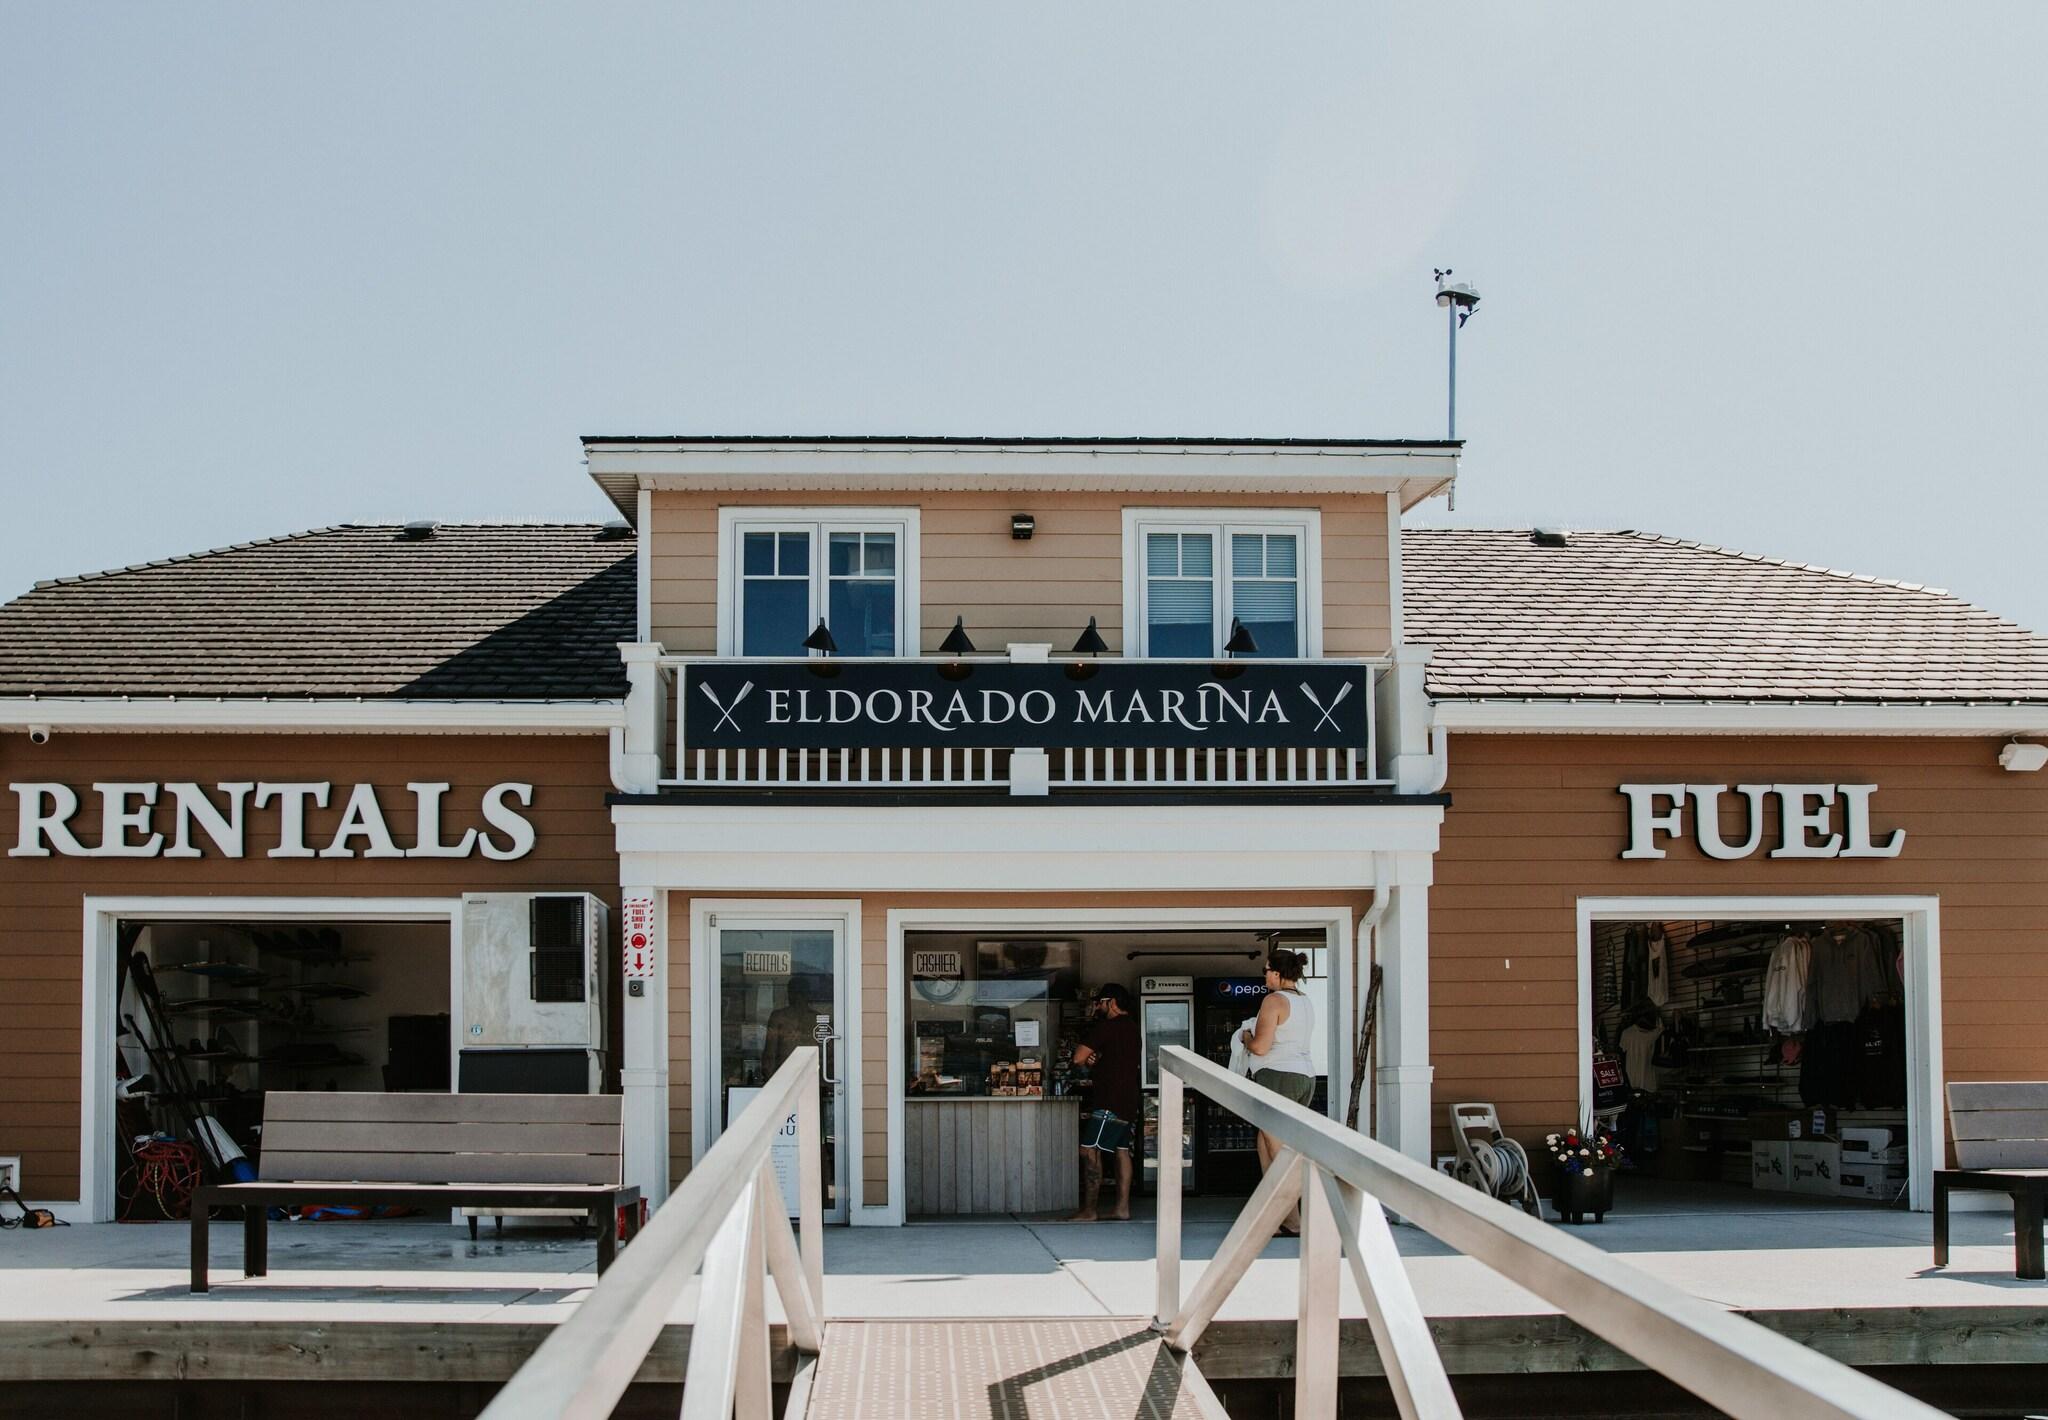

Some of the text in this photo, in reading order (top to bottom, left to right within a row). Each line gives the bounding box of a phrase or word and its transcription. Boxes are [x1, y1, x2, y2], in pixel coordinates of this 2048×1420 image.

[766, 682, 1290, 731] ELDORADO MARINA
[8, 781, 536, 861] RENTALS
[1619, 783, 1906, 860] FUEL
[746, 953, 788, 972] RENTALS
[916, 953, 957, 973] CASHIER
[1235, 984, 1269, 996] peps
[1600, 1069, 1616, 1077] SALE
